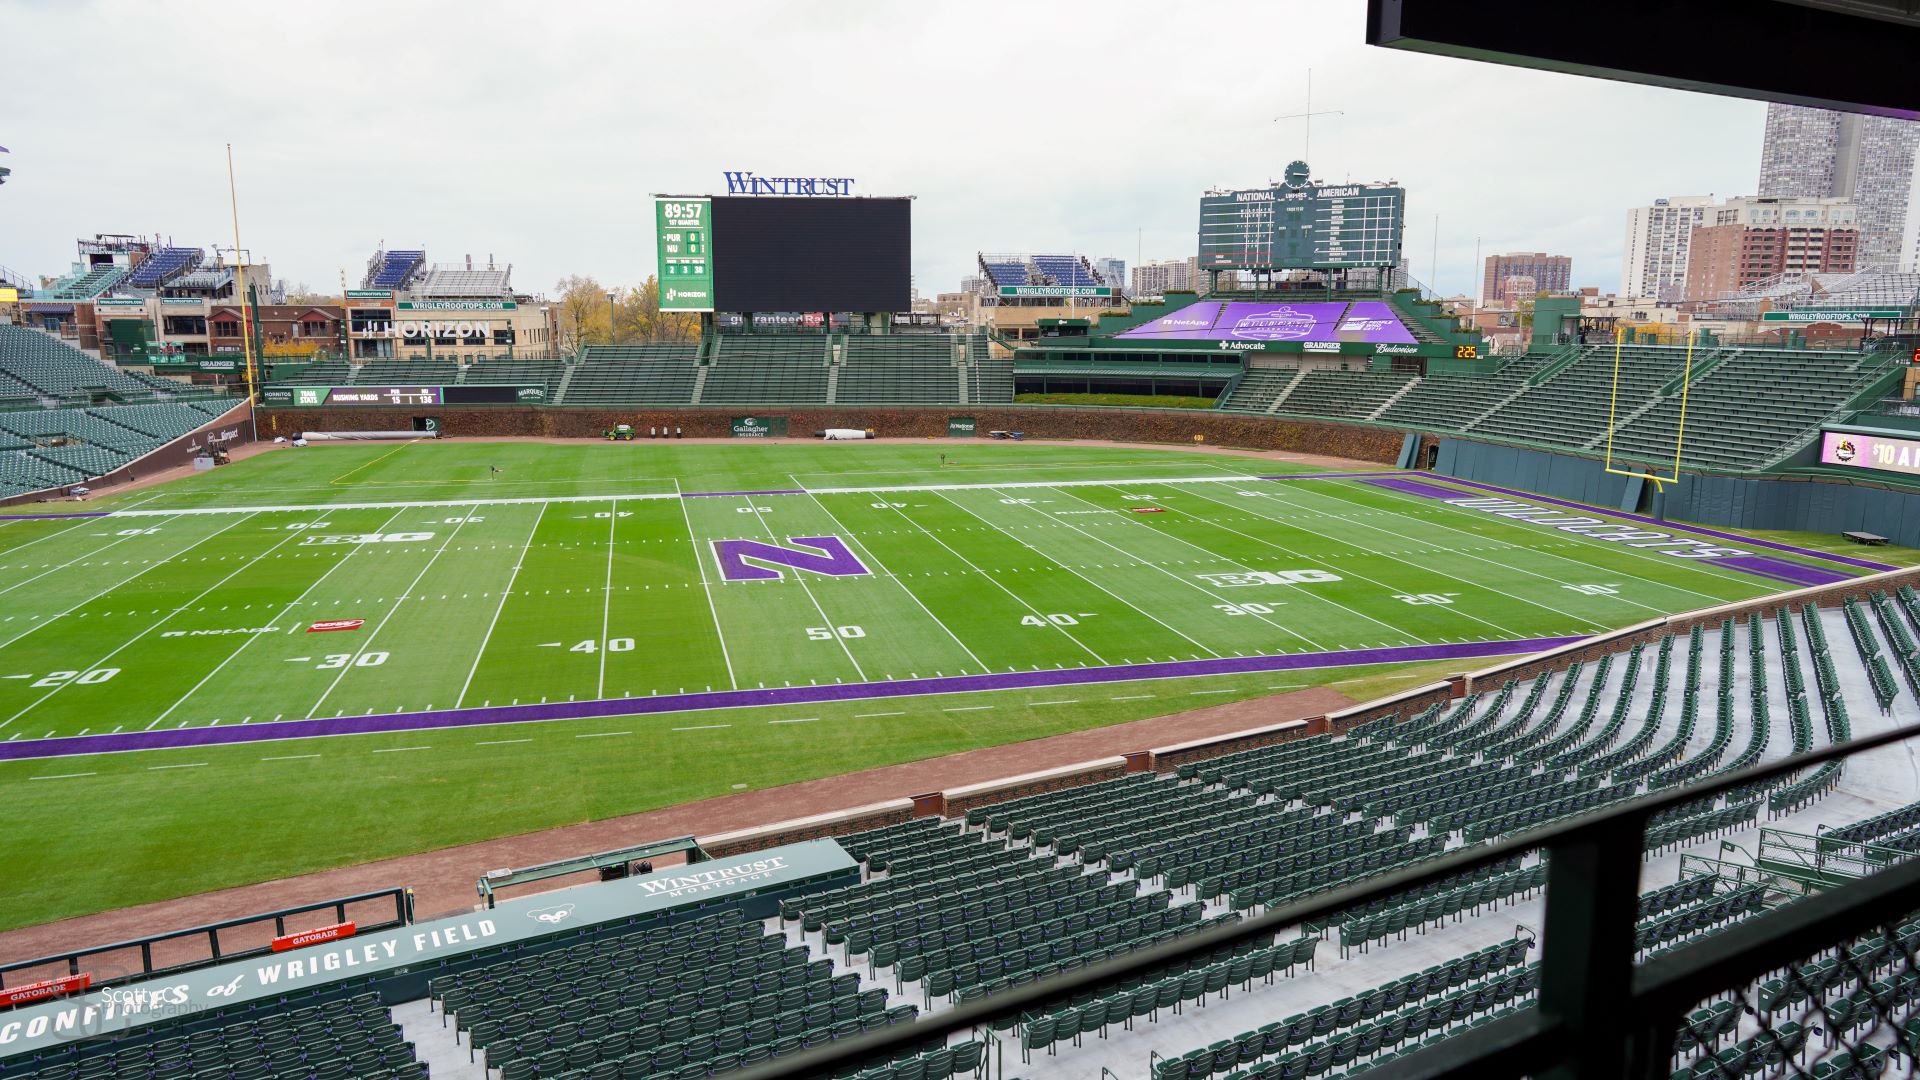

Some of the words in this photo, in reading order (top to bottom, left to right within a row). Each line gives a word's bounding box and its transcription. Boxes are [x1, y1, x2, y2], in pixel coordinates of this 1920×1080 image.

[723, 171, 855, 196] WINTRUST
[1236, 192, 1275, 202] NATIONAL
[1317, 187, 1359, 198] AMERICAN
[664, 203, 702, 218] 89:57
[666, 233, 681, 241] PUR
[690, 232, 695, 241] 0
[666, 244, 678, 253] NU
[690, 244, 696, 253] 0
[669, 266, 675, 274] 2
[683, 266, 688, 274] 3
[694, 266, 703, 274] 38
[1173, 318, 1209, 327] NetApp
[383, 321, 490, 339] HORIZON
[1230, 342, 1266, 350] Advocate
[1375, 343, 1418, 354] Budweiser
[1457, 346, 1475, 358] 2:25
[518, 388, 544, 397] MARQUEE
[420, 396, 432, 404] 136
[733, 425, 768, 434] Gallagher
[1872, 444, 1895, 465] $10
[1897, 448, 1910, 466] A
[594, 511, 634, 519] 40
[735, 506, 772, 514] 50
[285, 522, 332, 530] 20
[443, 516, 486, 524] 30
[116, 528, 163, 536] 10
[1442, 497, 1756, 559] WILDCATS
[708, 535, 873, 581] N
[1560, 583, 1620, 596] 10
[1392, 593, 1455, 606] 20
[1212, 602, 1275, 616] 30
[1020, 613, 1079, 627] 40
[189, 626, 281, 637] NetApp
[805, 625, 867, 641] 50
[569, 637, 636, 654] 40
[315, 651, 390, 669] 30
[29, 667, 122, 688] 20
[638, 856, 785, 893] WINTRUST
[669, 871, 772, 899] MORTGAGE
[292, 928, 338, 946] GATORADE
[207, 974, 246, 998] of
[256, 938, 399, 986] WRIGLEY
[413, 918, 496, 951] FIELD
[10, 983, 67, 1001] GATORADE
